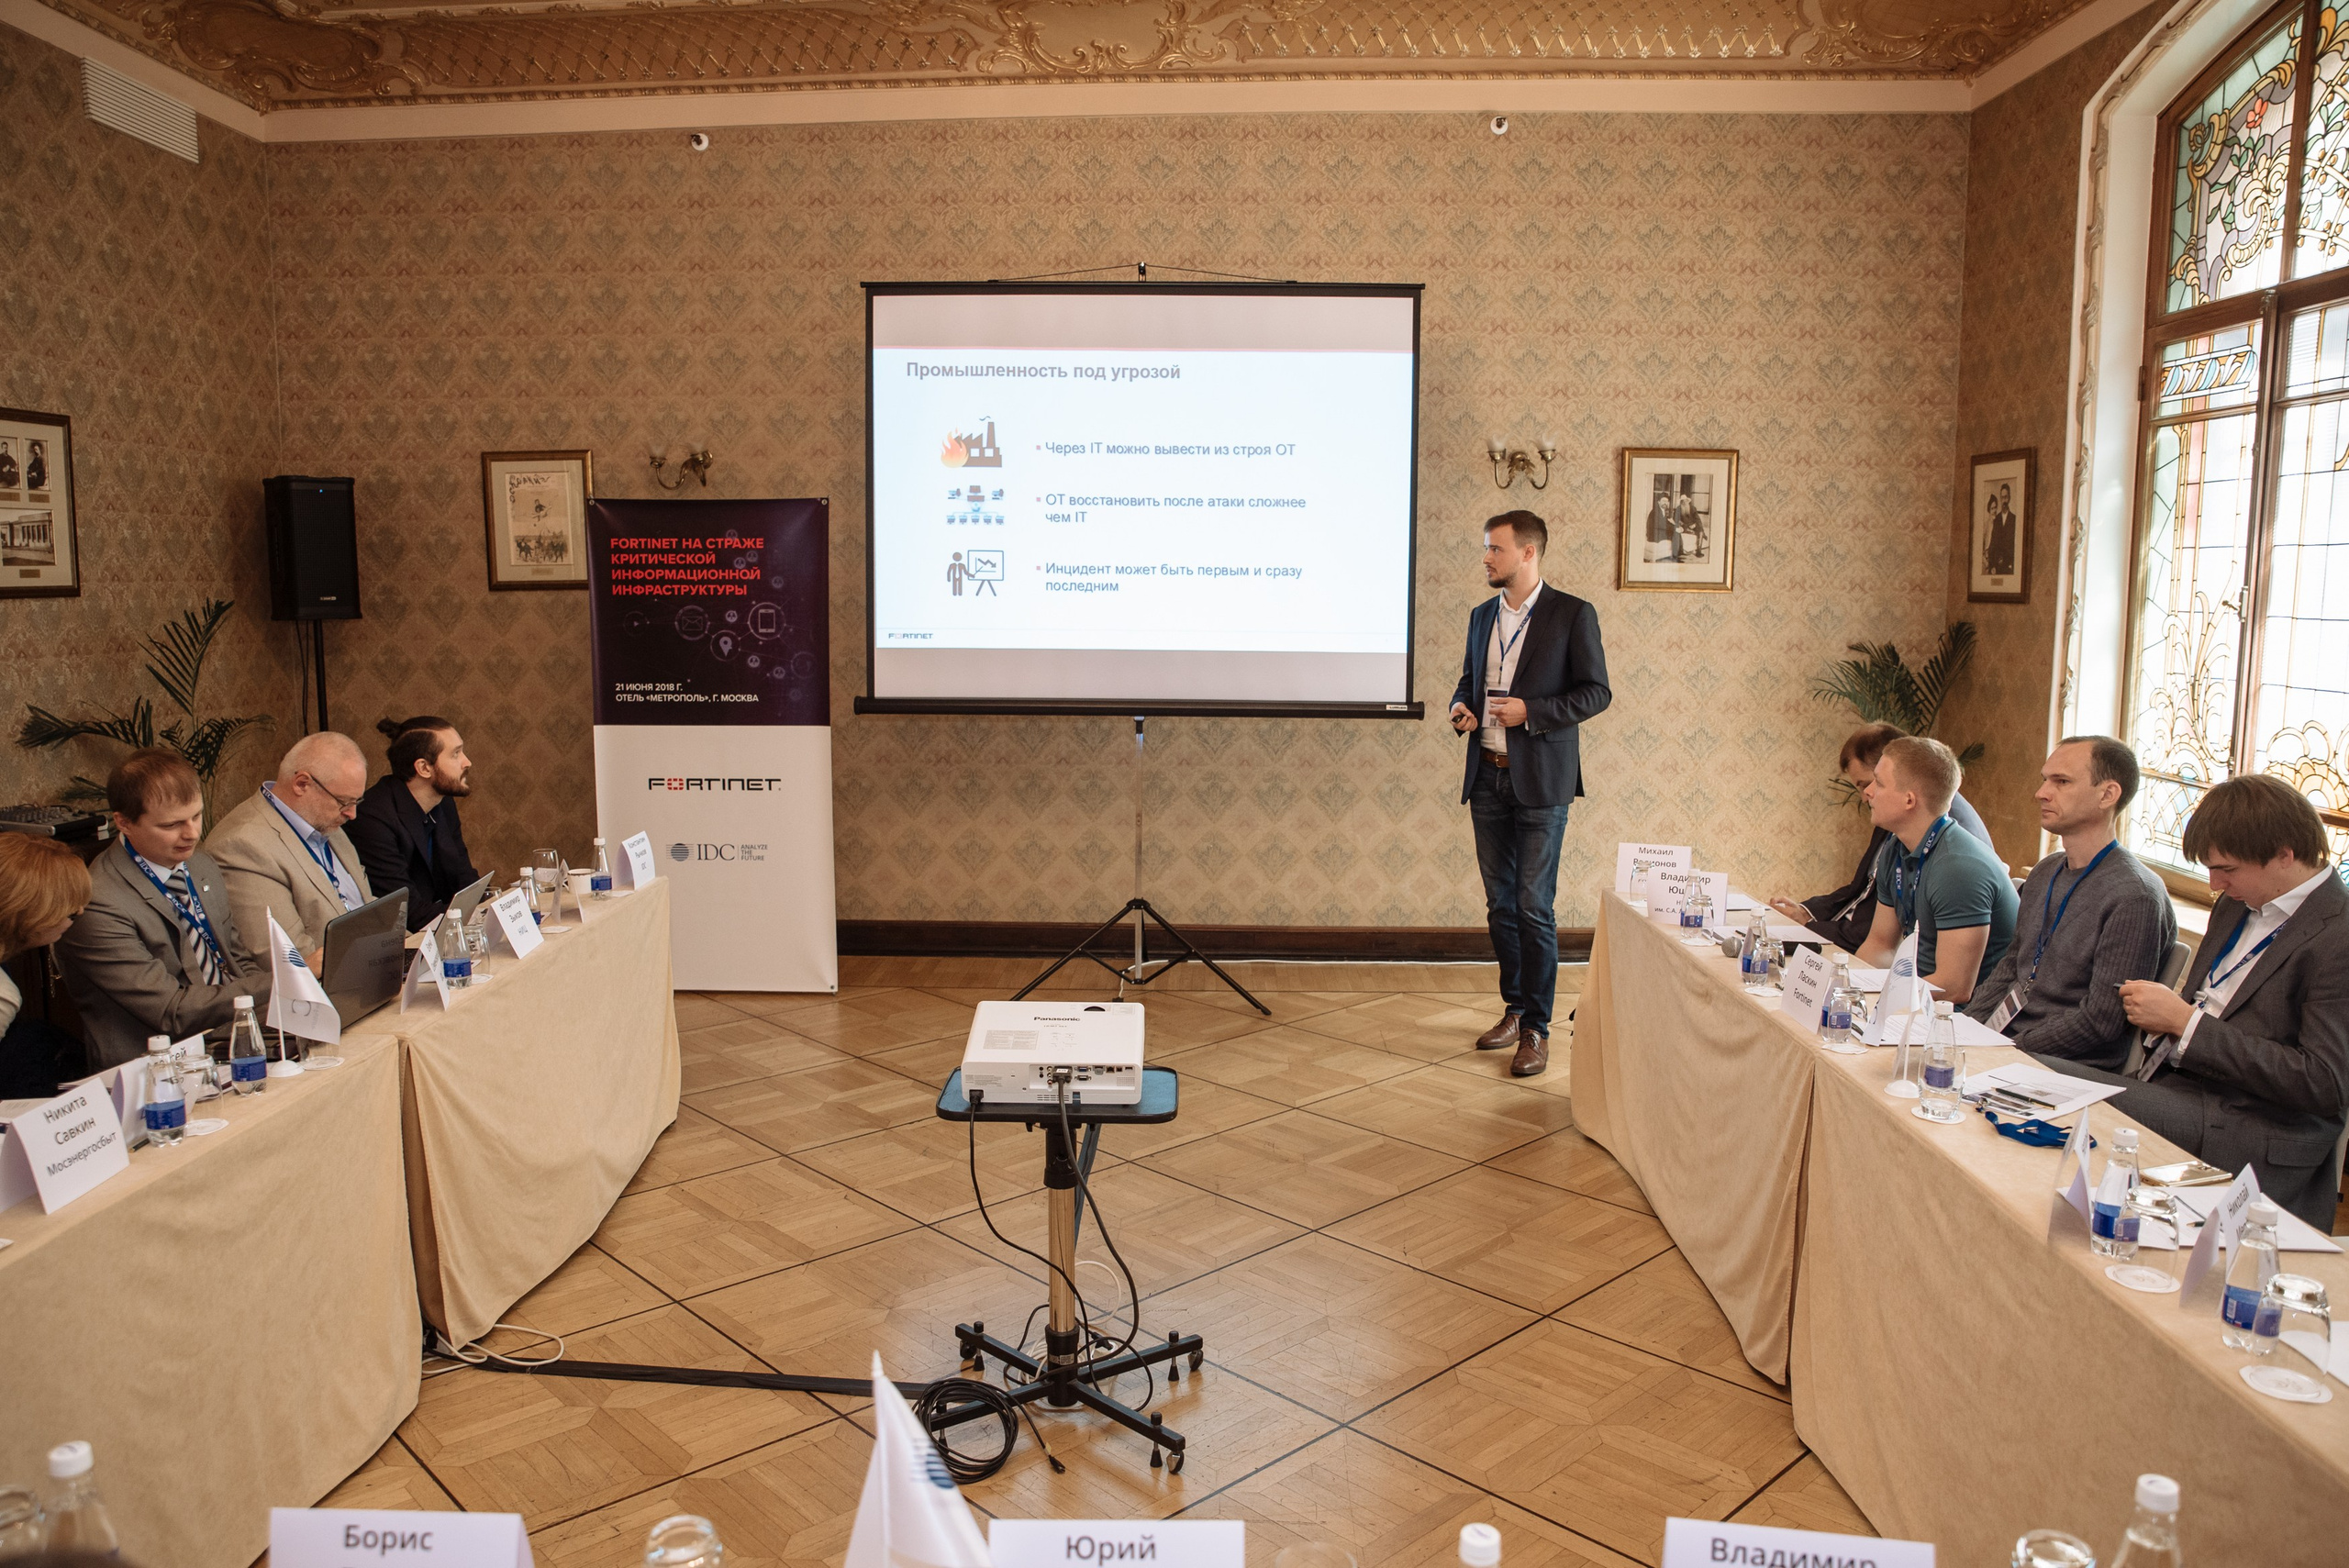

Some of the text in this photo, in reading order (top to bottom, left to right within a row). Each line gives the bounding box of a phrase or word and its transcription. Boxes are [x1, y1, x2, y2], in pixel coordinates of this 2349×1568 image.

[907, 362, 1181, 382] Промышленность под угрозой
[1045, 442, 1085, 457] Через
[1090, 442, 1103, 454] IT
[1107, 445, 1150, 455] можно
[1154, 445, 1210, 455] вывести
[1214, 445, 1229, 456] из
[1233, 446, 1271, 458] строя
[1069, 496, 1160, 507] восстановить
[1163, 496, 1203, 507] после
[1208, 497, 1244, 507] атаки
[1248, 497, 1307, 508] сложнее
[1045, 511, 1087, 523] чем IT
[610, 538, 764, 550] FORTINET НА СТРАЖЕ
[611, 551, 716, 564] КРИТИЧЕСКОЙ
[611, 567, 761, 582] ИНФОРМАЦИОННОЙ
[1045, 562, 1302, 579] Инцидент может быть первым и сразу
[612, 584, 748, 596] ИНФРАСТРУКТУРЫ
[1045, 581, 1119, 594] последним
[626, 684, 653, 692] ИЮНЯ
[655, 684, 674, 692] 2018
[676, 684, 684, 692] Г.
[616, 694, 759, 704] ОТЕЛЬ «МЕТРОПОЛЬ», Г. МОСКВА
[648, 778, 782, 792] FORTINET
[696, 843, 736, 862] IDC
[1638, 847, 1674, 856] Михаил
[1660, 873, 1711, 884] Владиир
[1805, 955, 1823, 972] Сергей
[1798, 971, 1817, 988] Ласкин
[1793, 987, 1812, 1008] Fortinet
[43, 1095, 88, 1124] Никита
[54, 1117, 96, 1145] Савкин
[47, 1131, 117, 1177] Мосэнергосбыт
[2227, 1182, 2250, 1219] Николай
[344, 1524, 433, 1557] Борис
[1065, 1533, 1157, 1567] Юрий
